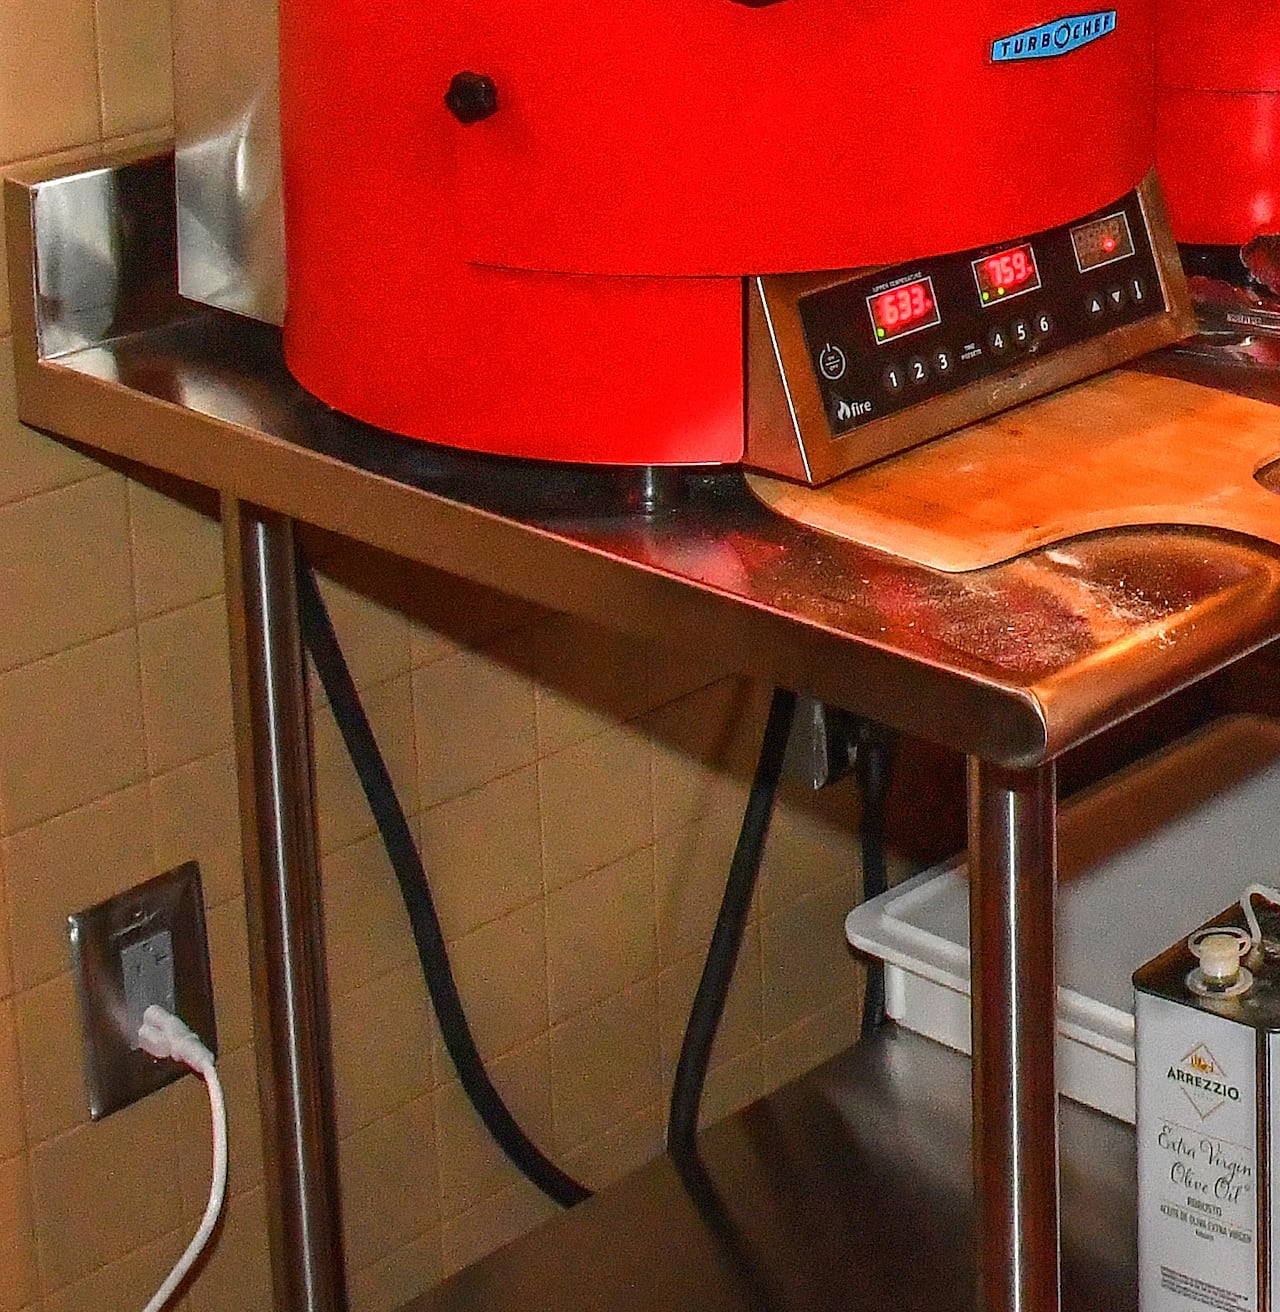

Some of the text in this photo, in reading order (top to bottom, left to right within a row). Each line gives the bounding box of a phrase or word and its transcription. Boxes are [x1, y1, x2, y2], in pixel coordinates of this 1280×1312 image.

[1001, 15, 1110, 57] TURBOCHEF
[987, 252, 1028, 286] 759
[882, 285, 927, 325] 633
[1040, 316, 1049, 332] 6
[994, 333, 1004, 349] 4
[1017, 325, 1026, 341] 5
[938, 353, 948, 369] 3
[889, 371, 897, 387] 1
[914, 363, 925, 379] 2
[850, 400, 872, 417] fire
[1167, 1066, 1240, 1102] ARREZZIO
[1158, 1125, 1251, 1182] Extra Virgin
[1171, 1162, 1243, 1204] Olive Oil
